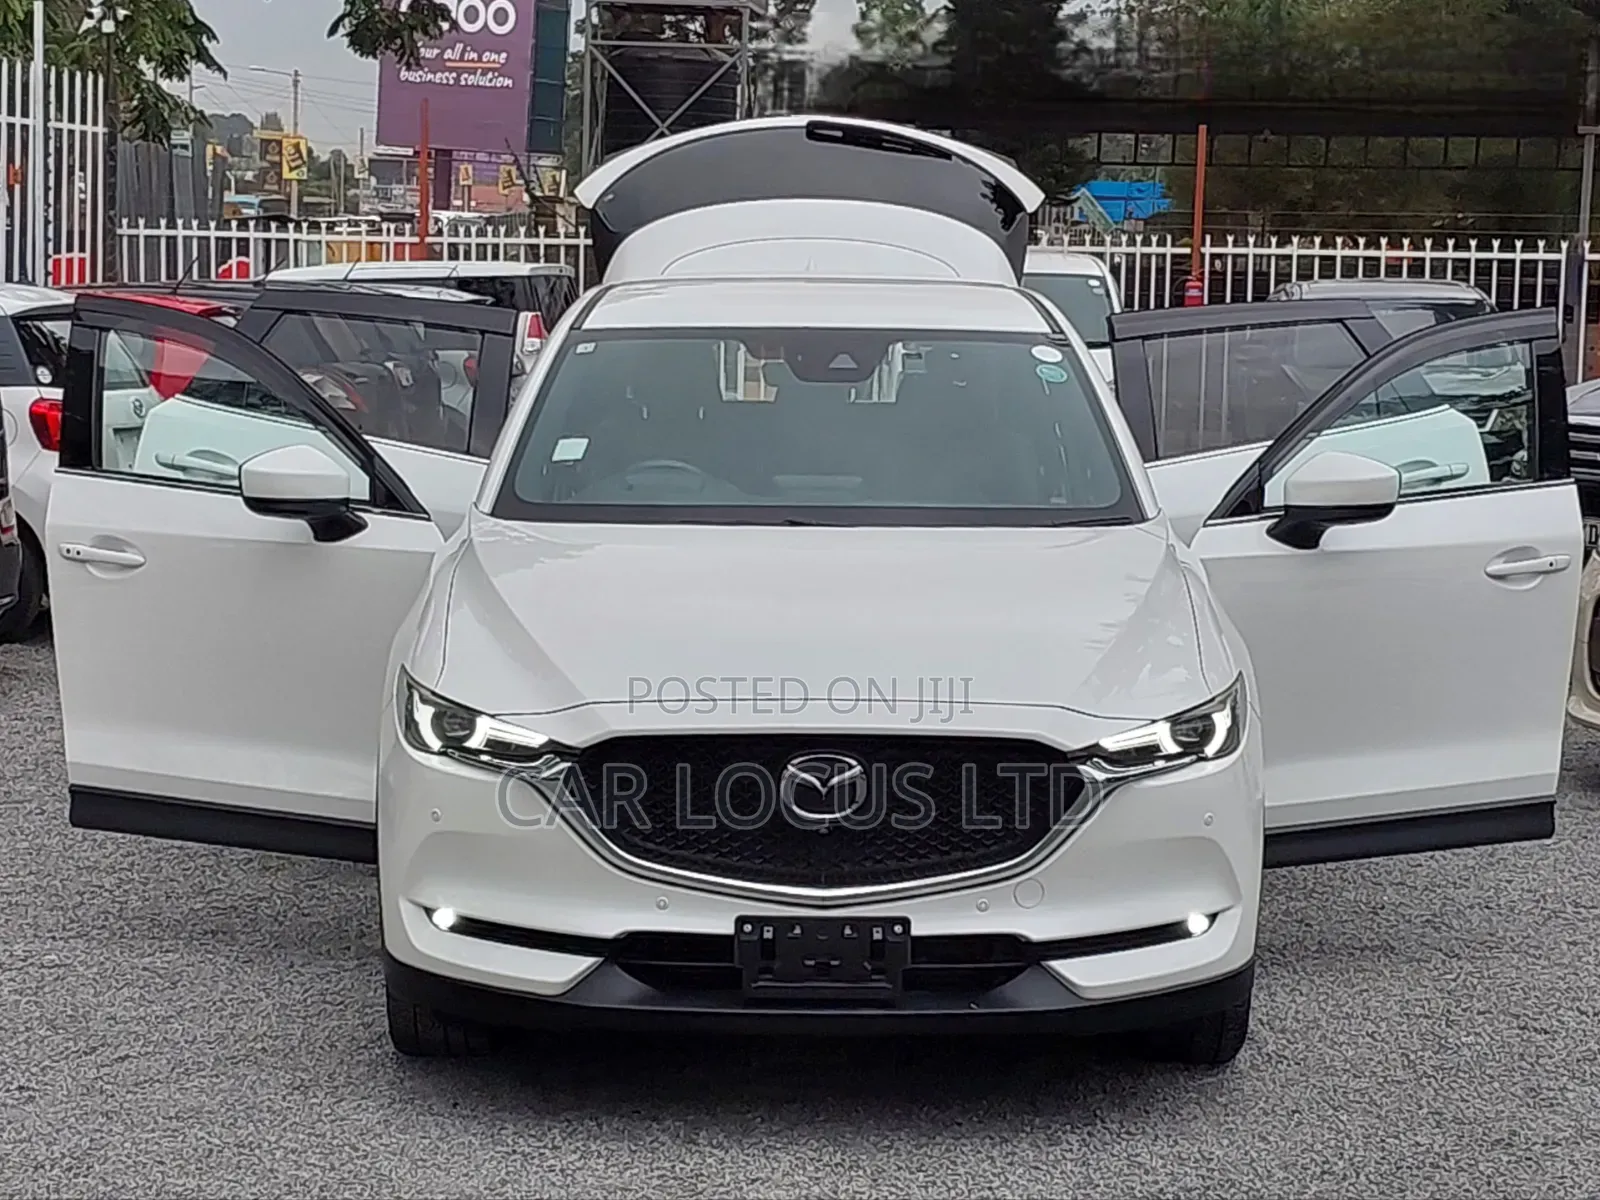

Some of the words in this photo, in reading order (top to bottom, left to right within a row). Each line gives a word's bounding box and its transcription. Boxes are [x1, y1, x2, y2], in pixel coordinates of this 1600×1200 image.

[417, 41, 441, 59] our
[443, 42, 464, 61] all
[464, 46, 478, 62] in
[482, 51, 508, 63] one
[400, 67, 457, 85] business
[459, 68, 513, 88] solution
